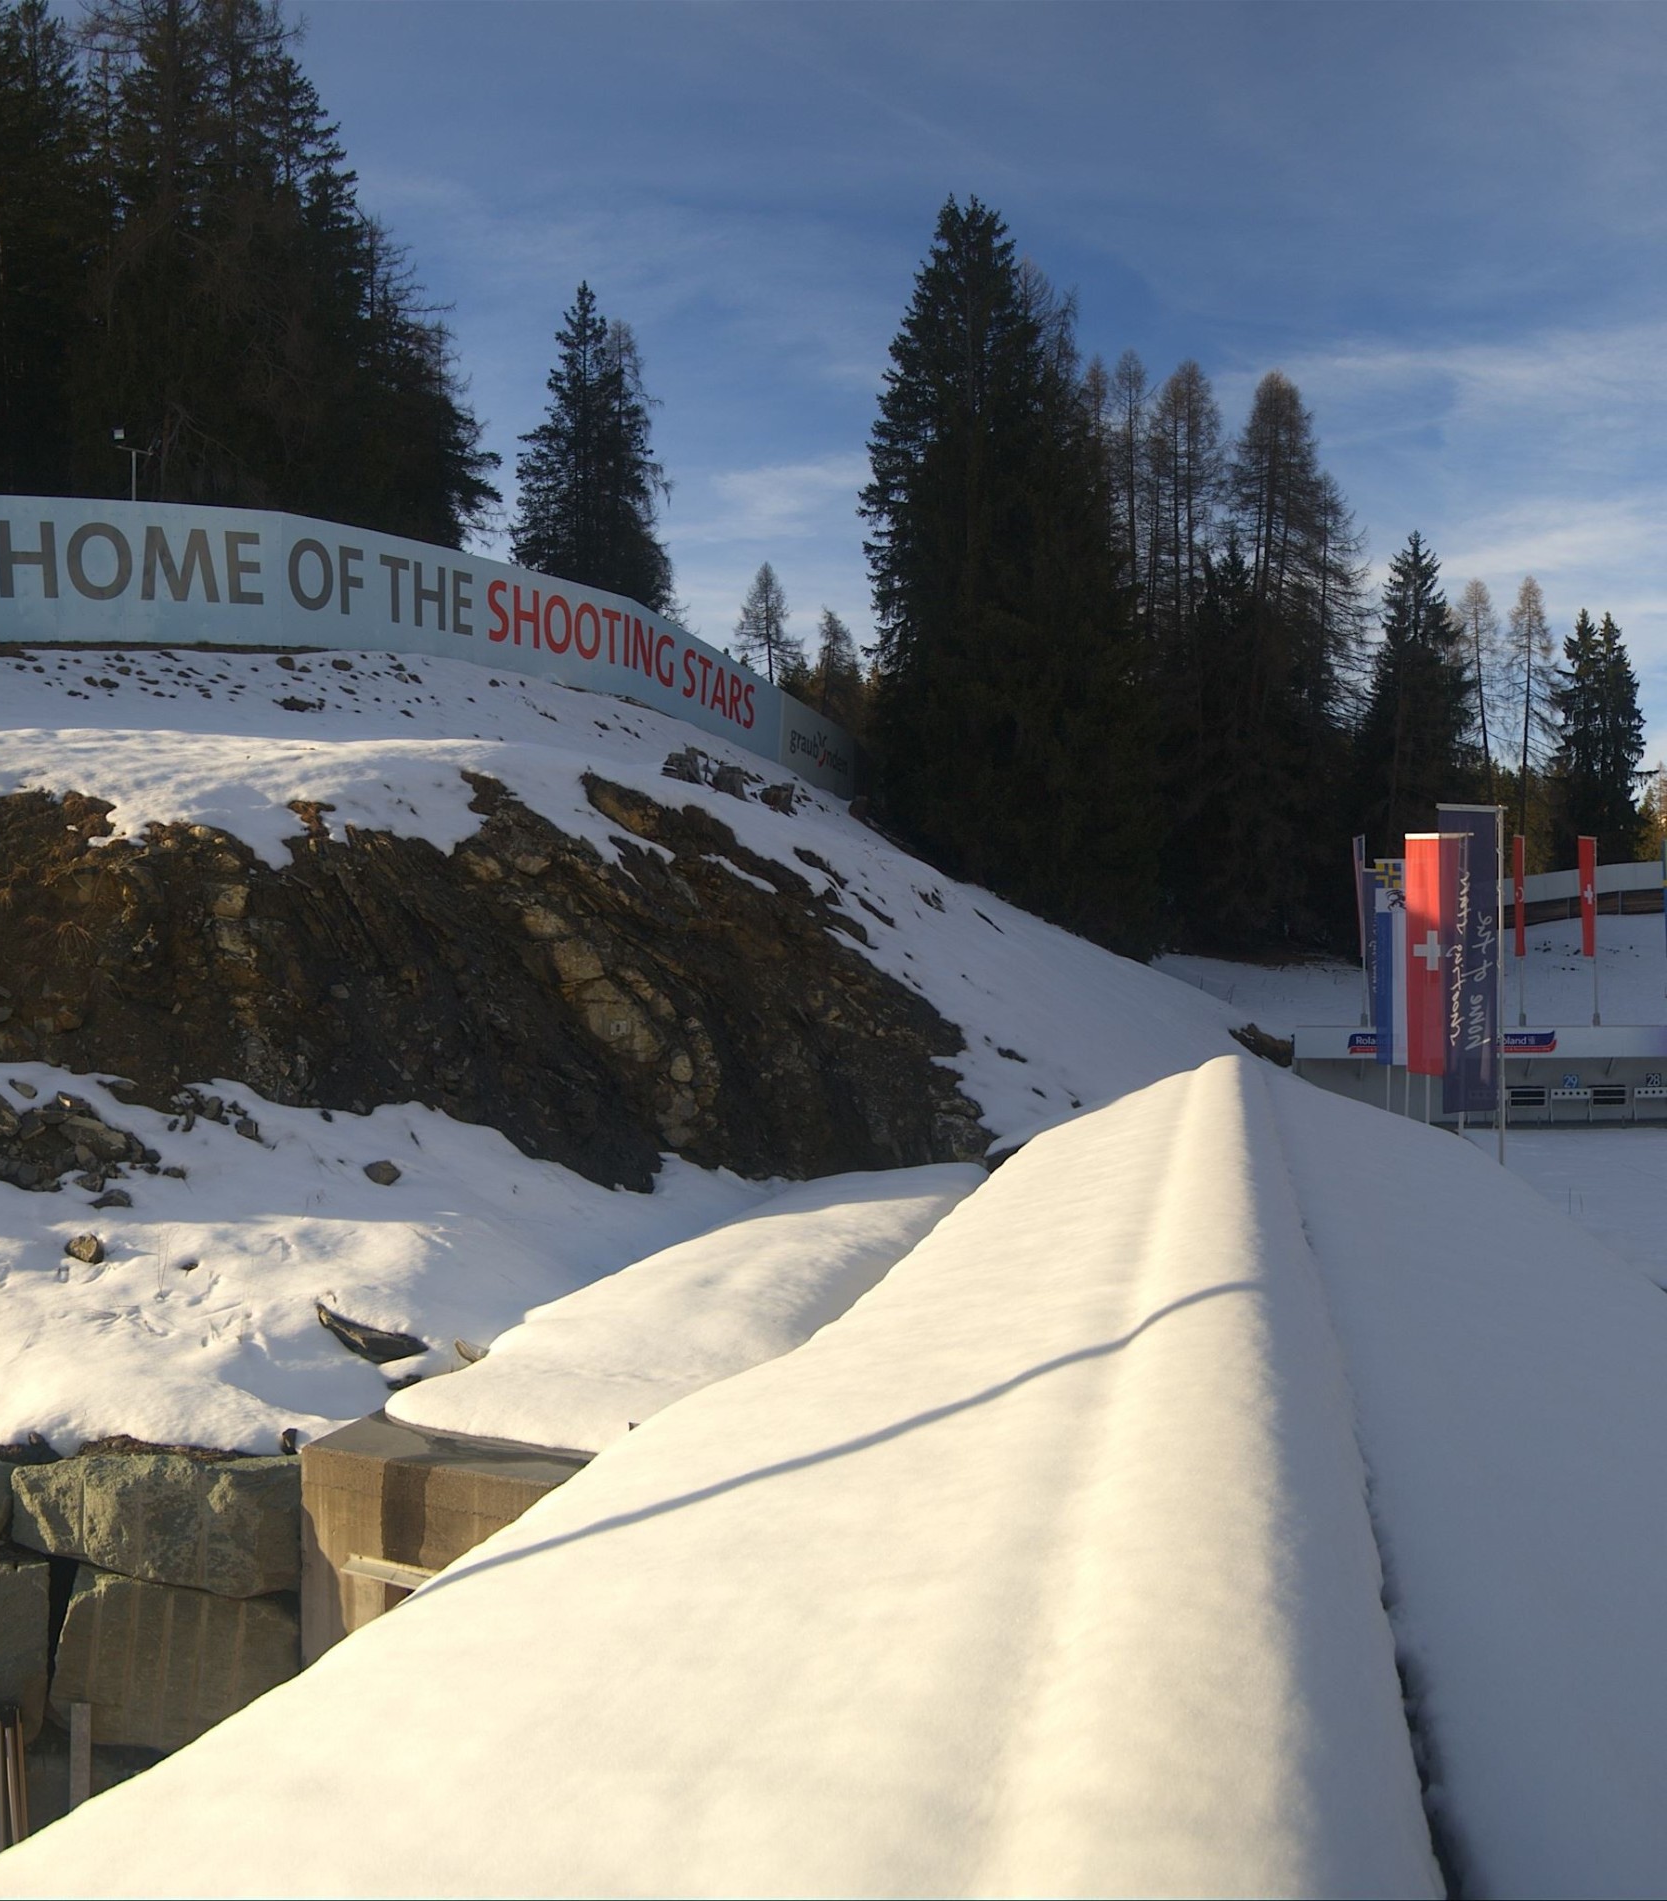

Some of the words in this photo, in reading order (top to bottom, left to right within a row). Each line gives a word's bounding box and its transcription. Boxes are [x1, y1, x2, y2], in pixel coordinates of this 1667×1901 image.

[288, 537, 364, 615] OF
[379, 554, 473, 636] THE
[487, 580, 675, 688] SHOOTING
[682, 647, 757, 730] STARS
[1564, 1075, 1578, 1087] 29
[1647, 1074, 1660, 1086] 28
